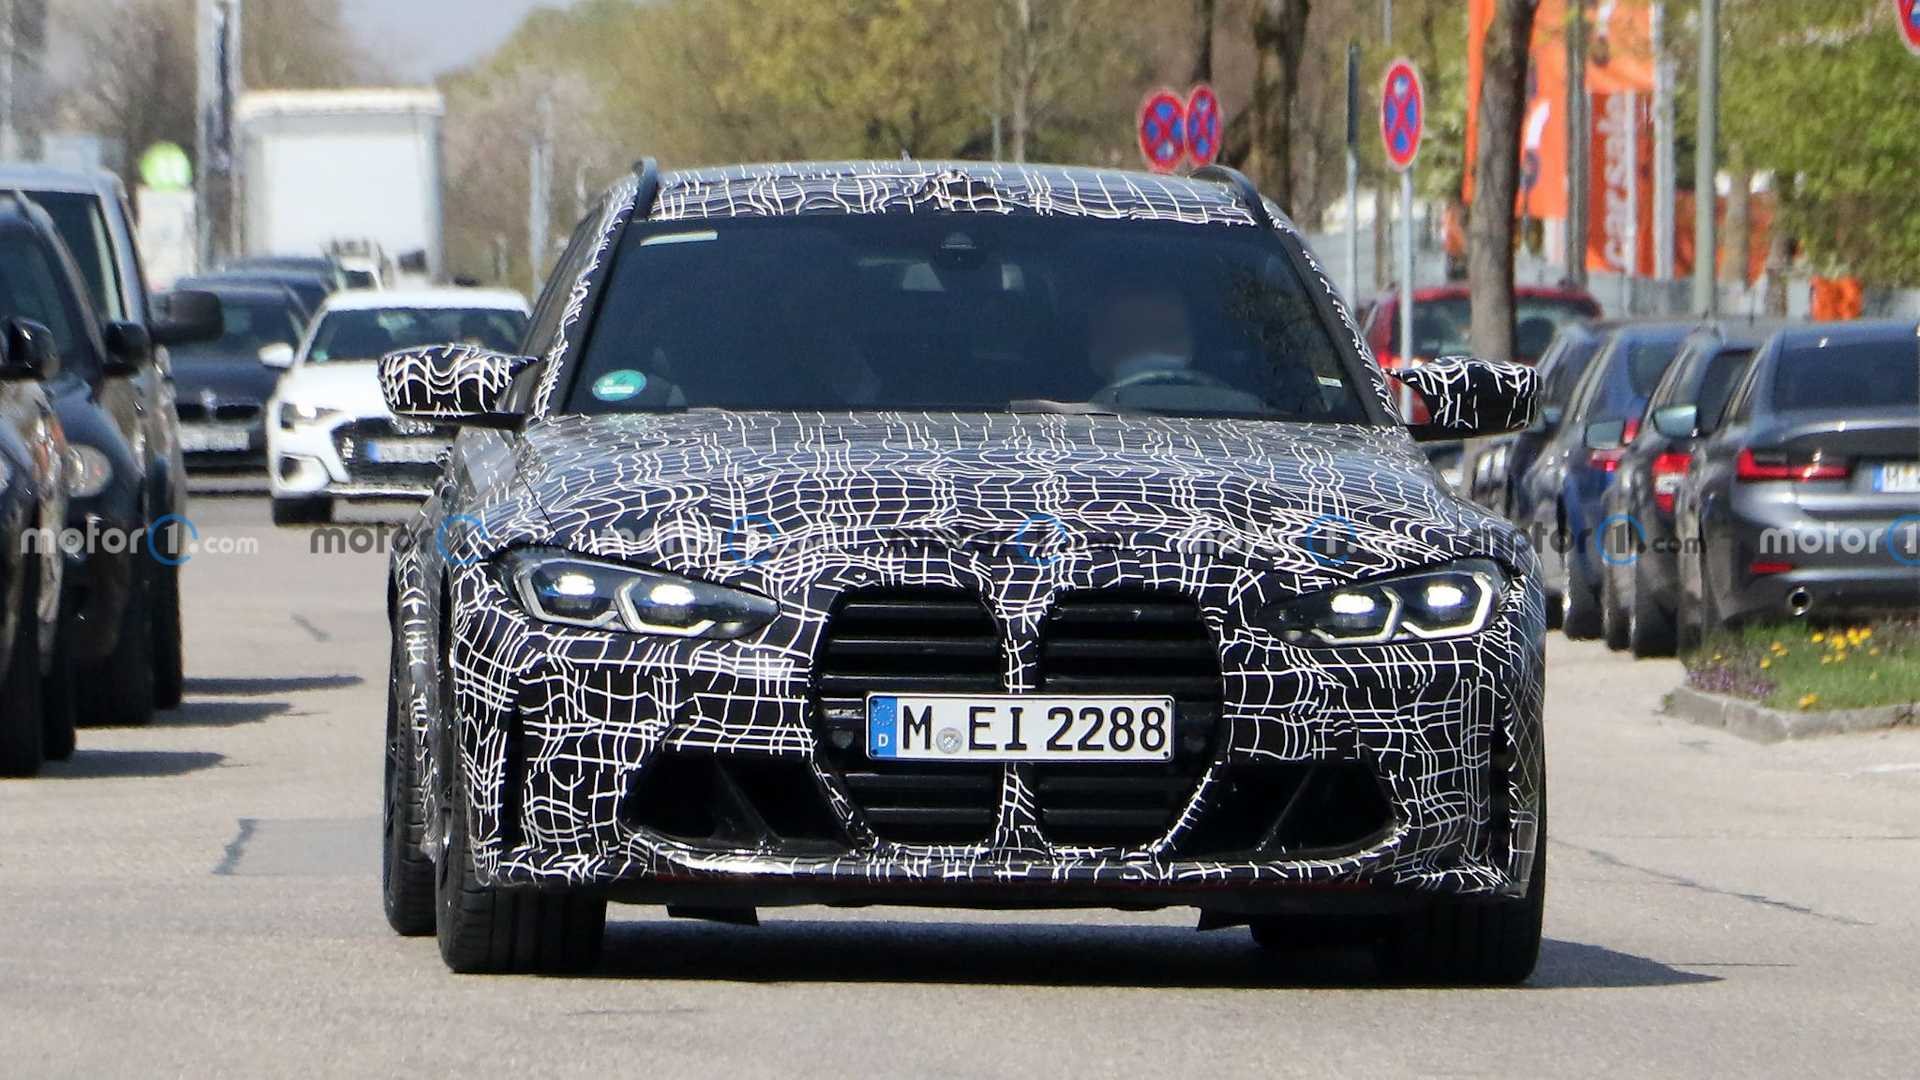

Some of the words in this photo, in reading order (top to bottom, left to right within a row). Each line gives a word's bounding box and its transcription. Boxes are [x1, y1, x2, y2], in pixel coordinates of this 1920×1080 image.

[902, 705, 932, 750] M
[968, 706, 1028, 751] EI
[1046, 706, 1167, 752] 2288
